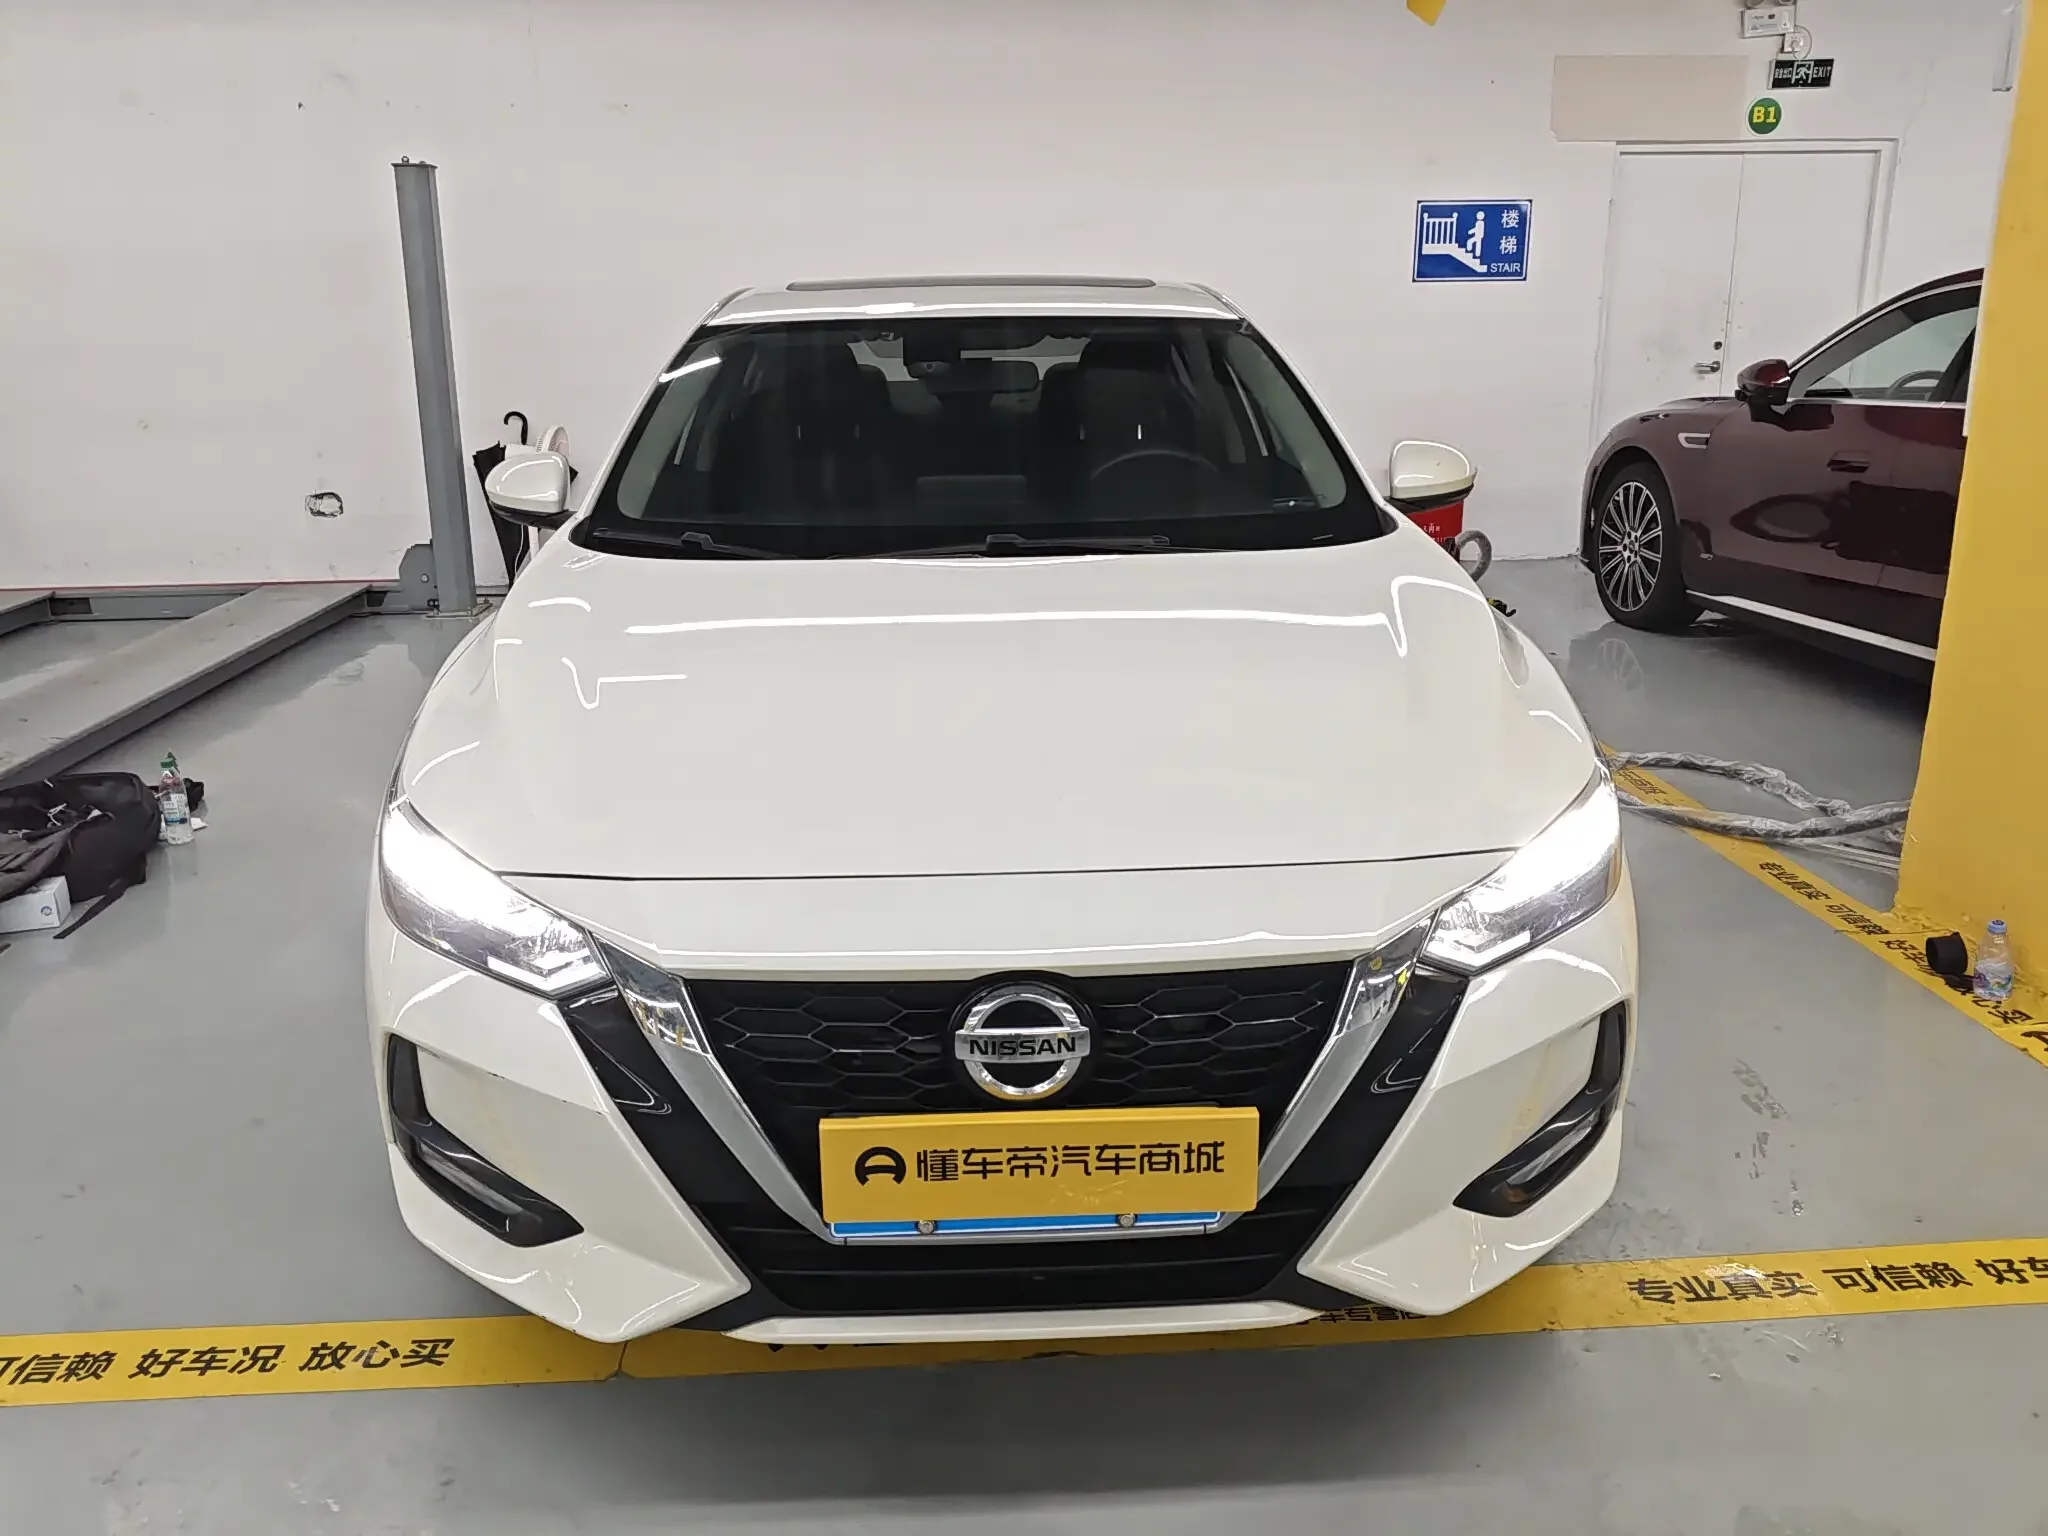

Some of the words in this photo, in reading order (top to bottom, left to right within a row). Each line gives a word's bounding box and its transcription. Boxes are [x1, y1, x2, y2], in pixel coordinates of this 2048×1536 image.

[1812, 66, 1832, 78] EXIT
[1752, 106, 1777, 123] B1
[1499, 209, 1520, 255] 楼梯
[1490, 262, 1521, 273] STAIR
[1759, 862, 1832, 900] 专业真实
[1825, 904, 1890, 935] 可信赖
[969, 1036, 1077, 1057] NISSAN
[915, 1141, 1225, 1183] 懂车帝汽车商城
[1627, 1271, 1822, 1304] 专业真实
[1822, 1261, 1974, 1293] 可信赖
[128, 1344, 287, 1380] 好车况
[299, 1338, 456, 1372] 放心买
